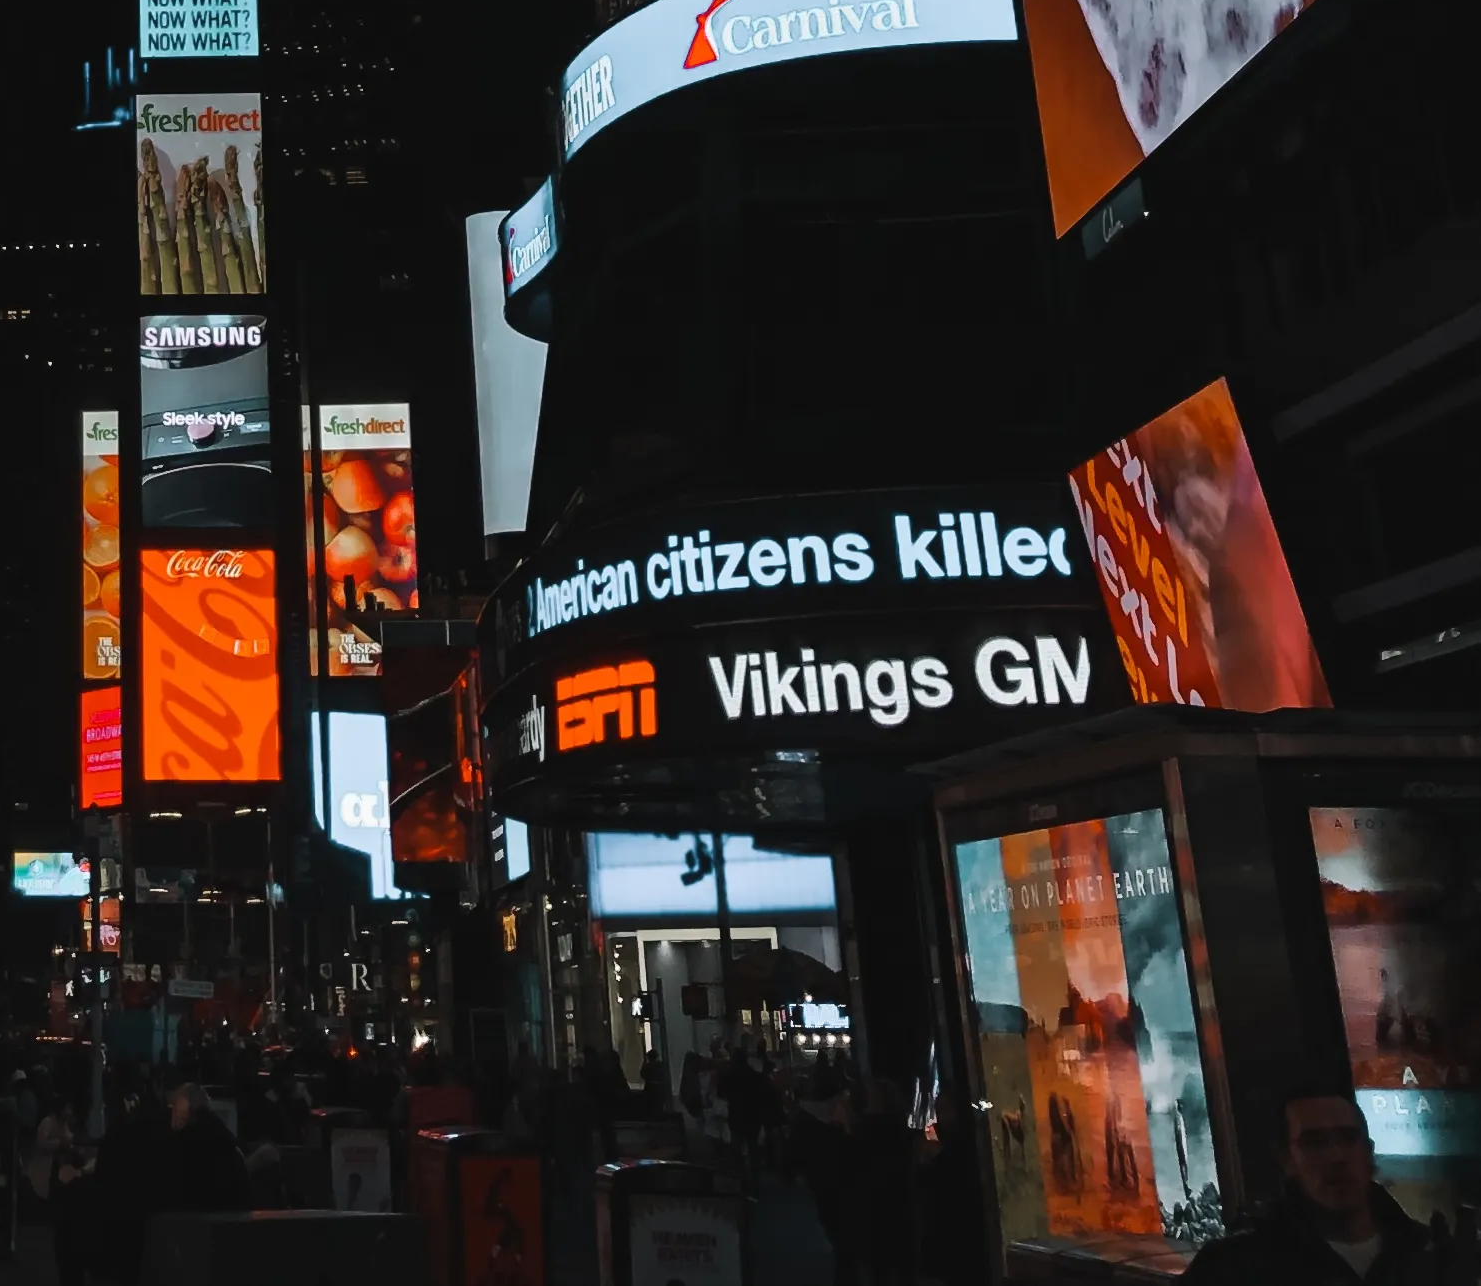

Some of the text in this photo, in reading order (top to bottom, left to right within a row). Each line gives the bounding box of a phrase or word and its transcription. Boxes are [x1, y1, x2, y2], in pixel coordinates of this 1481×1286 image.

[148, 10, 251, 29] NOW WHAT?
[148, 32, 251, 51] NOW WHAT?
[140, 103, 261, 134] freshdirect
[512, 214, 551, 278] Carnival
[144, 325, 262, 348] SAMSUNG
[162, 411, 246, 431] Sleek style
[330, 414, 406, 436] freshdirect
[166, 549, 247, 579] Coca-Cola
[1086, 459, 1189, 649] Level
[535, 559, 639, 634] American
[646, 529, 876, 601] citizens
[340, 633, 355, 644] THE
[340, 654, 349, 664] IS
[708, 646, 955, 728] Vikings
[556, 659, 658, 752] ESPN
[968, 866, 1171, 914] A YEAR ON PLANET EARTH
[1402, 1066, 1419, 1085] A
